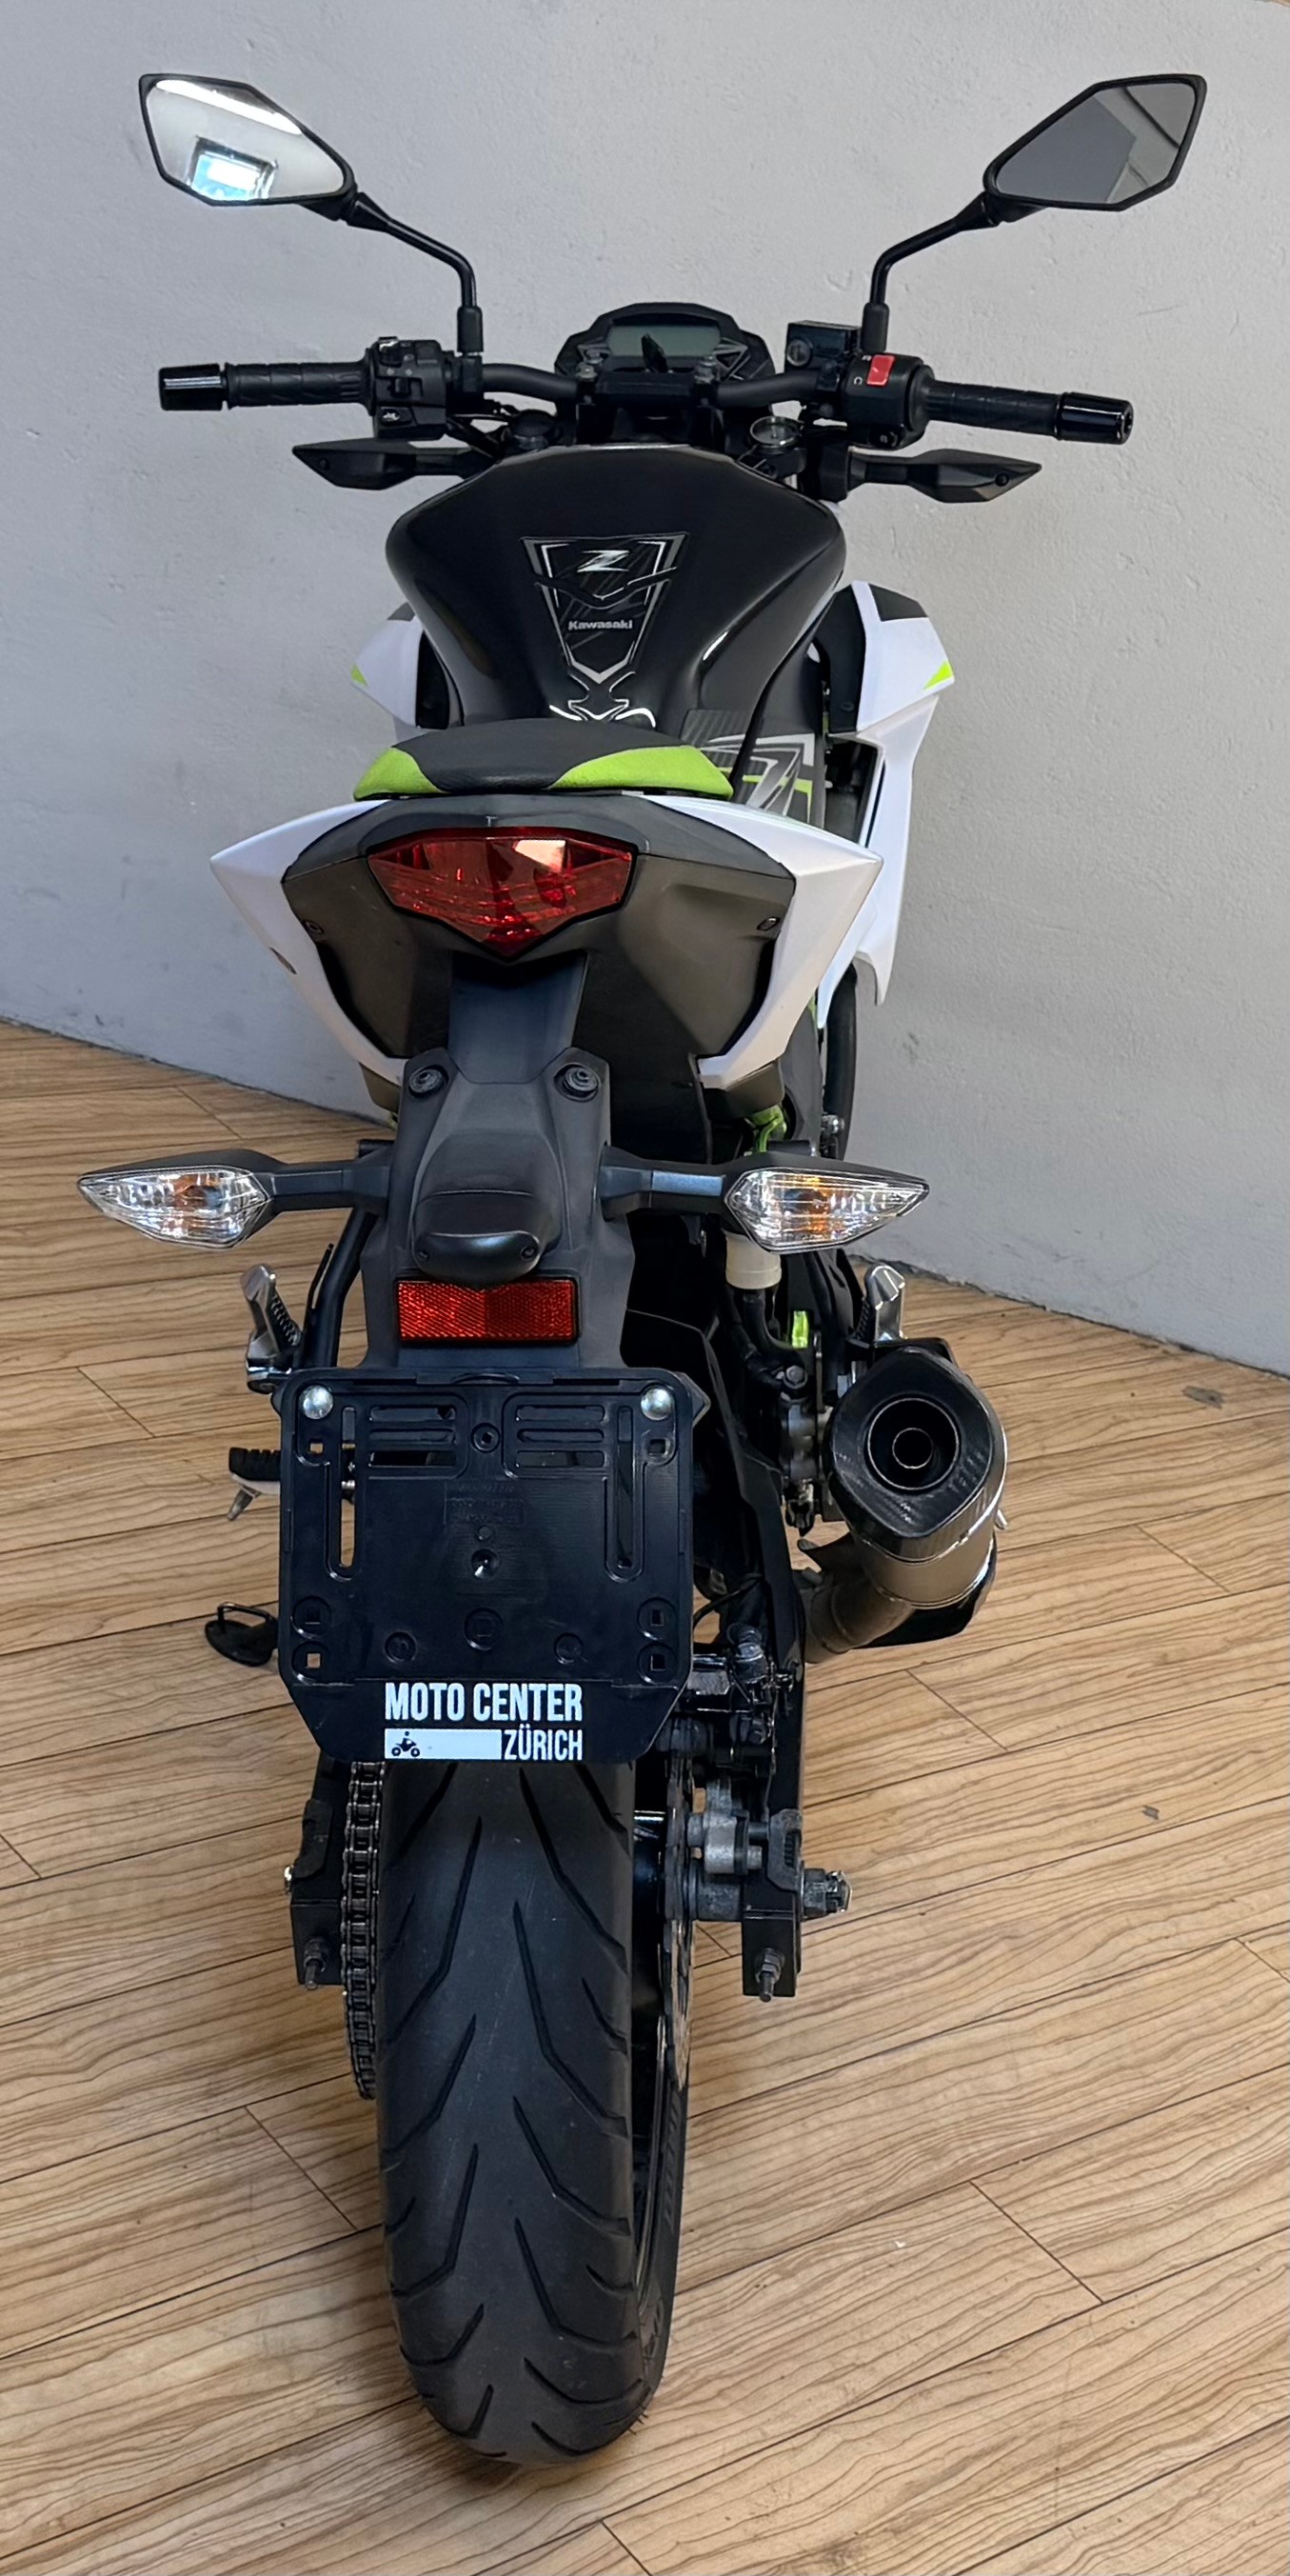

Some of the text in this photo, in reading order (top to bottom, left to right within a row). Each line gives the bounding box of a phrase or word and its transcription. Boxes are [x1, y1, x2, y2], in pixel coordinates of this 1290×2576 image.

[577, 549, 629, 573] Z
[568, 619, 633, 630] Kawasaki
[385, 1682, 583, 1722] MOTO CENTER
[504, 1724, 583, 1761] ZÜRICH
